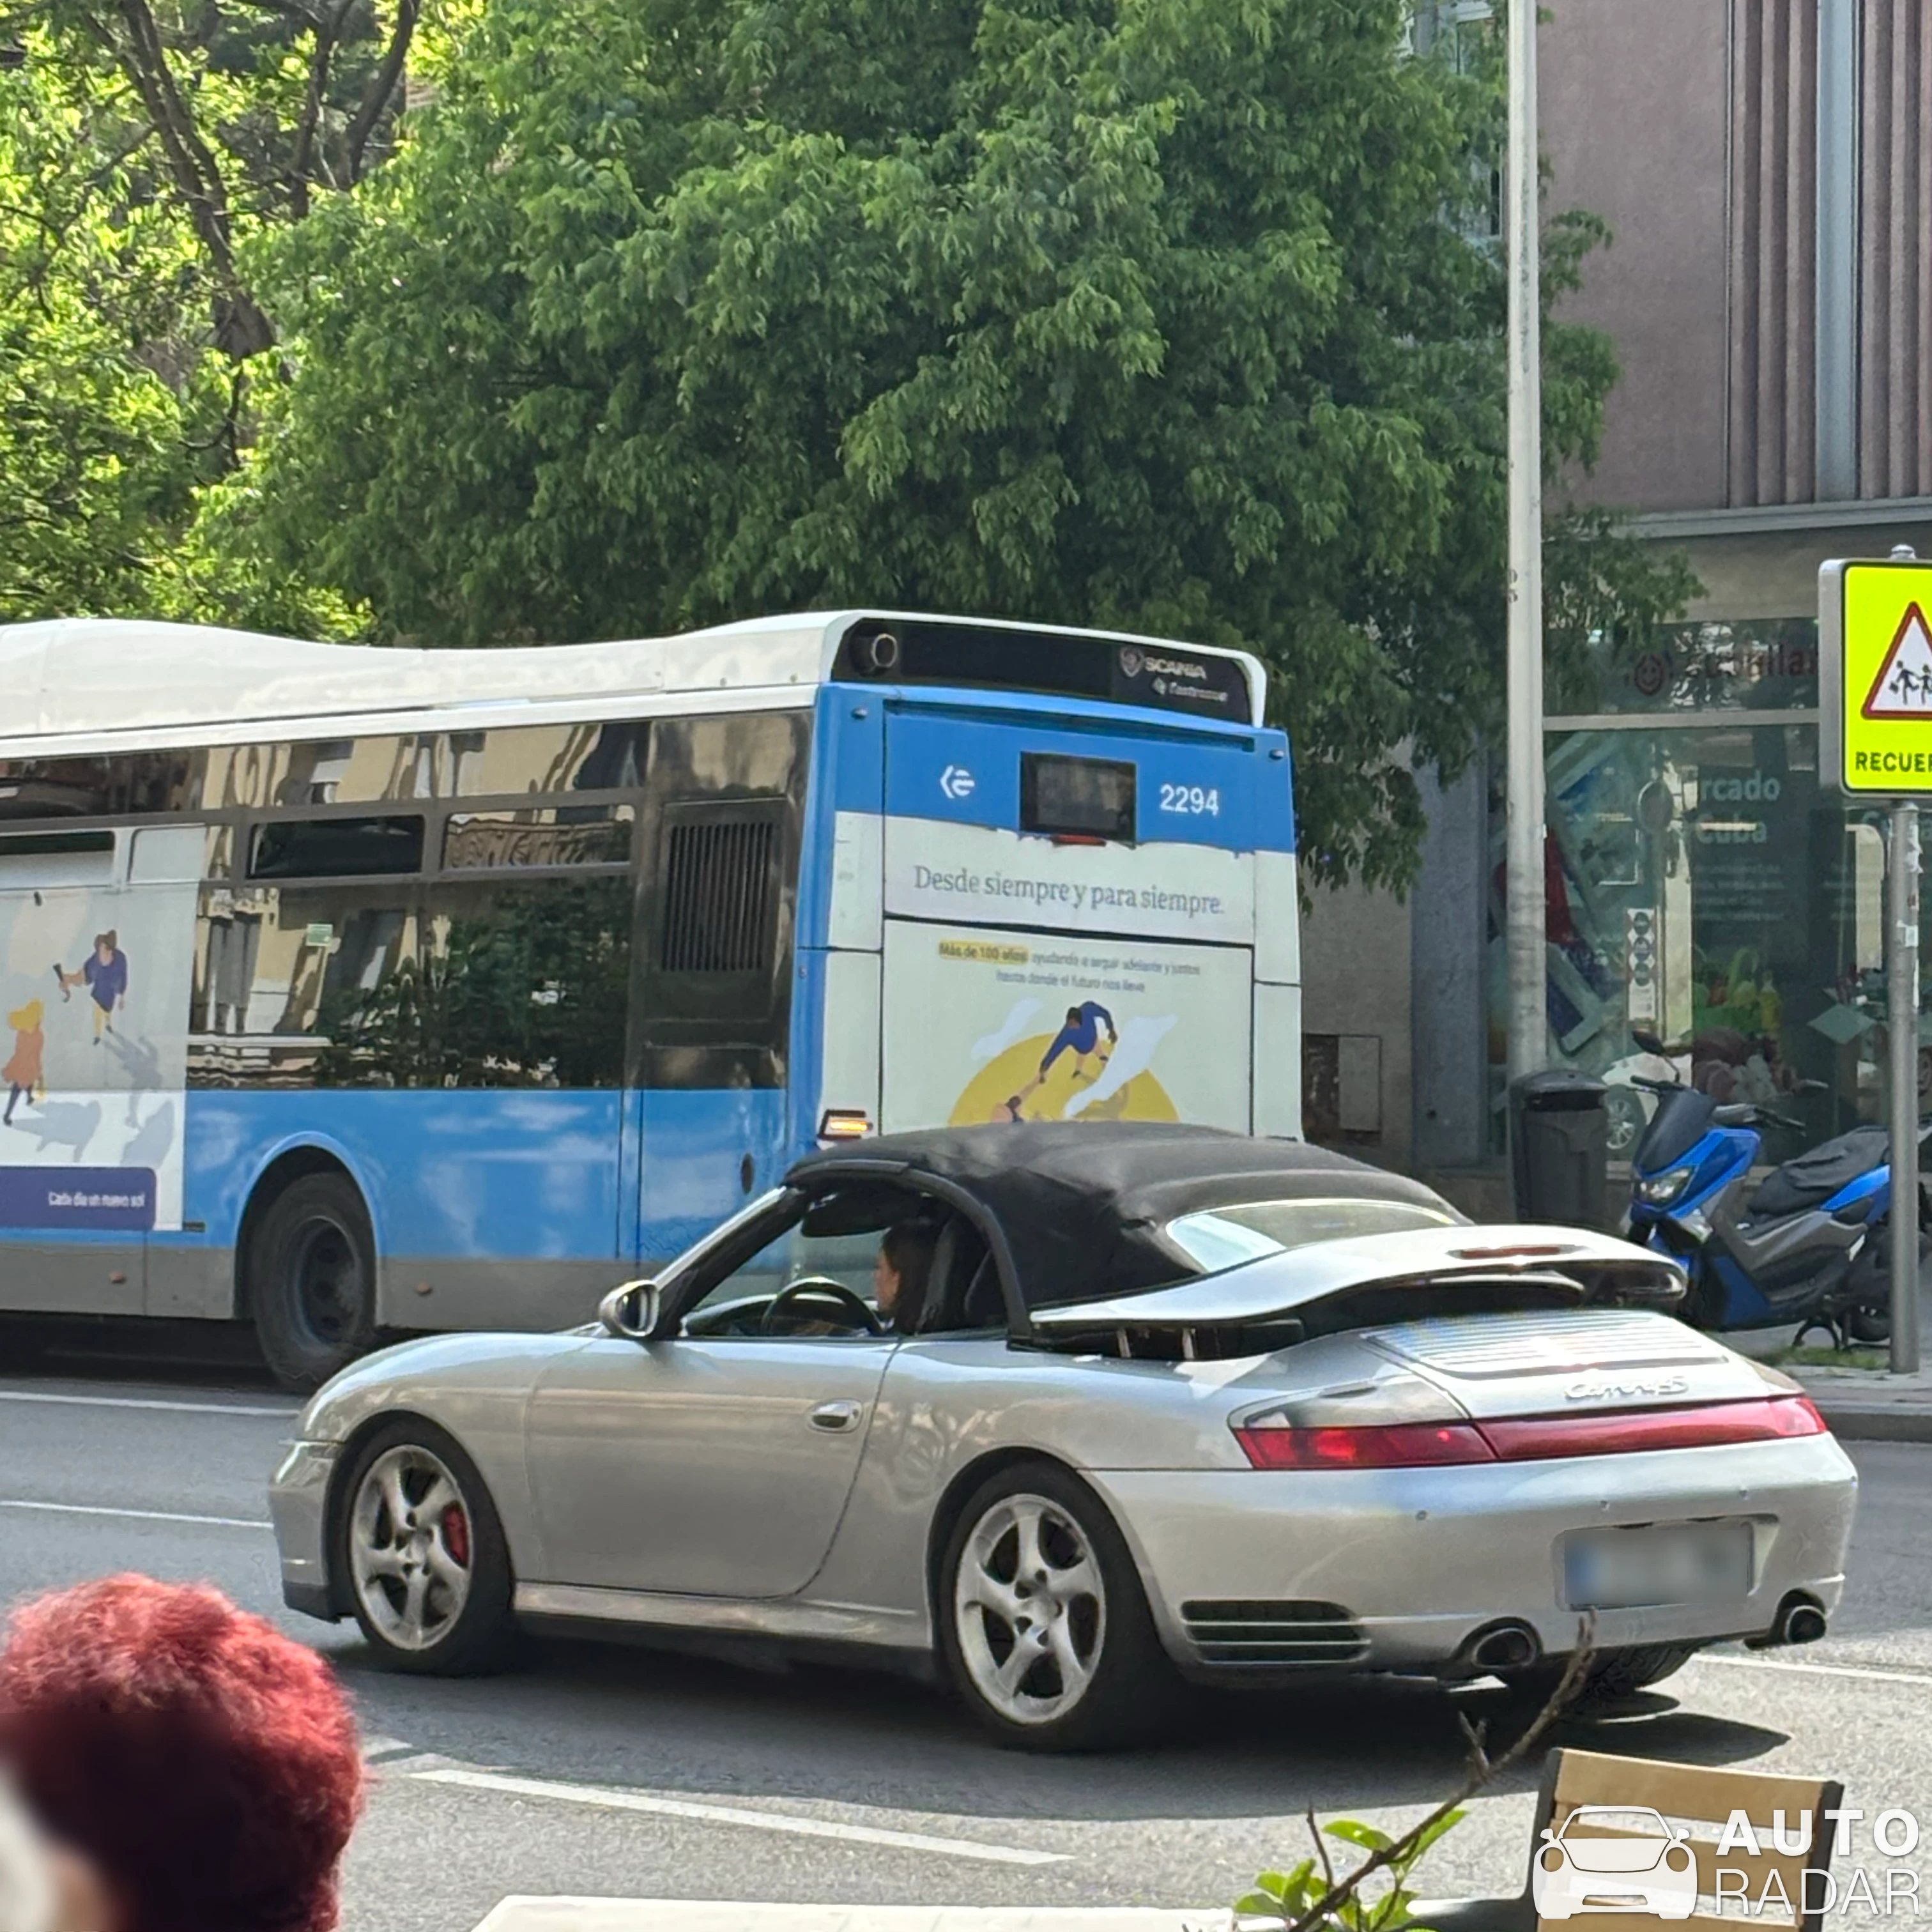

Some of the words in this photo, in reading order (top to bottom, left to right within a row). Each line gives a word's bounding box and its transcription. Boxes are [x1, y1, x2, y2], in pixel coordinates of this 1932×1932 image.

[1160, 783, 1219, 816] 2294
[914, 864, 981, 894] Desde
[985, 871, 1070, 907] siempre
[1072, 884, 1087, 909] y
[1091, 885, 1137, 910] para
[1140, 884, 1225, 919] siempre.
[963, 945, 978, 957] de
[979, 946, 999, 959] 100
